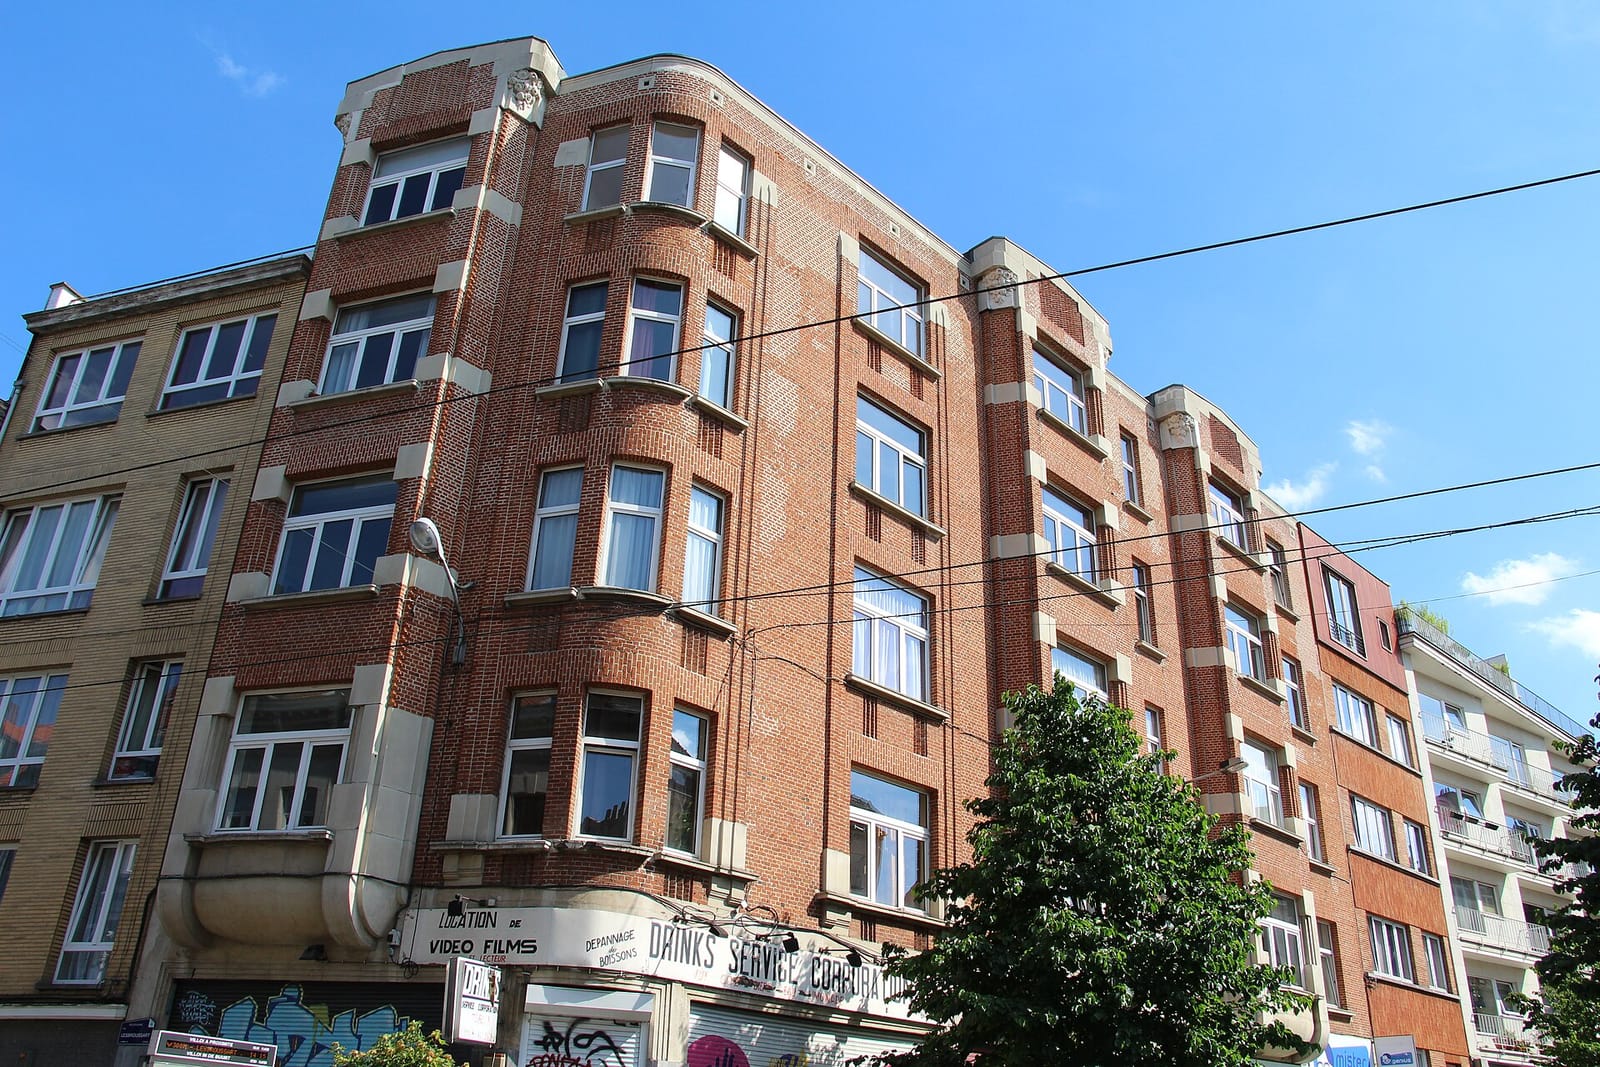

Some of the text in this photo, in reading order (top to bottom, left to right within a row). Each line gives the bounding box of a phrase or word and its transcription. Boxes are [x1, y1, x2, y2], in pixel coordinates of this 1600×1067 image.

[439, 911, 522, 929] LOCATION DE
[429, 939, 538, 954] VIDEO FILMS
[585, 929, 636, 953] DEPANNAGE
[480, 954, 507, 963] LECTEUR
[599, 947, 638, 968] BOISSONS
[649, 921, 716, 969] DRINKS
[728, 938, 799, 985] SERVICE
[462, 964, 502, 1002] DRINS
[1335, 1049, 1367, 1067] mister
